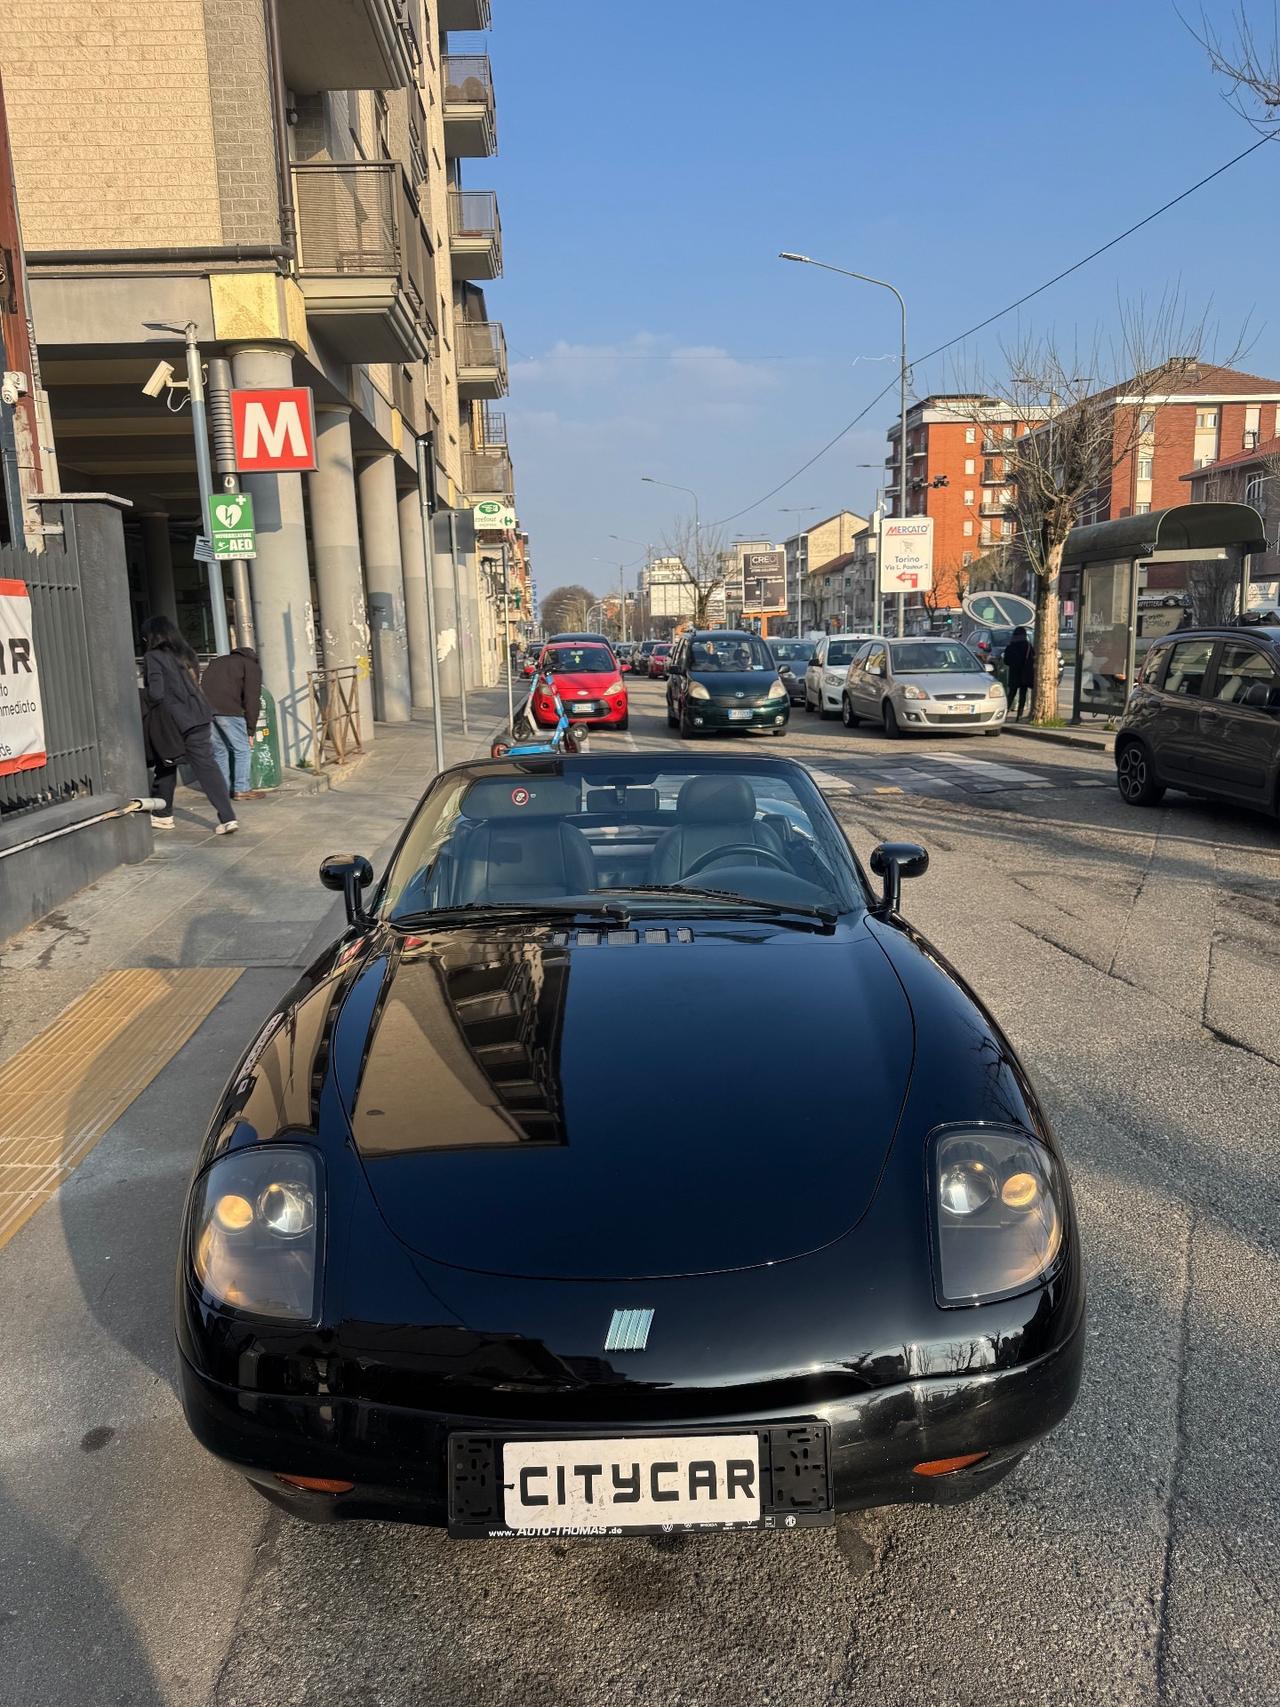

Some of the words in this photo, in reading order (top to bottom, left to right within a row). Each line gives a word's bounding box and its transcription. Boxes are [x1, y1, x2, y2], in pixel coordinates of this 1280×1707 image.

[242, 401, 309, 459] M
[887, 525, 928, 535] MERCATO
[229, 538, 254, 551] AED
[895, 554, 920, 563] Torino
[520, 1460, 756, 1507] CITYCAR
